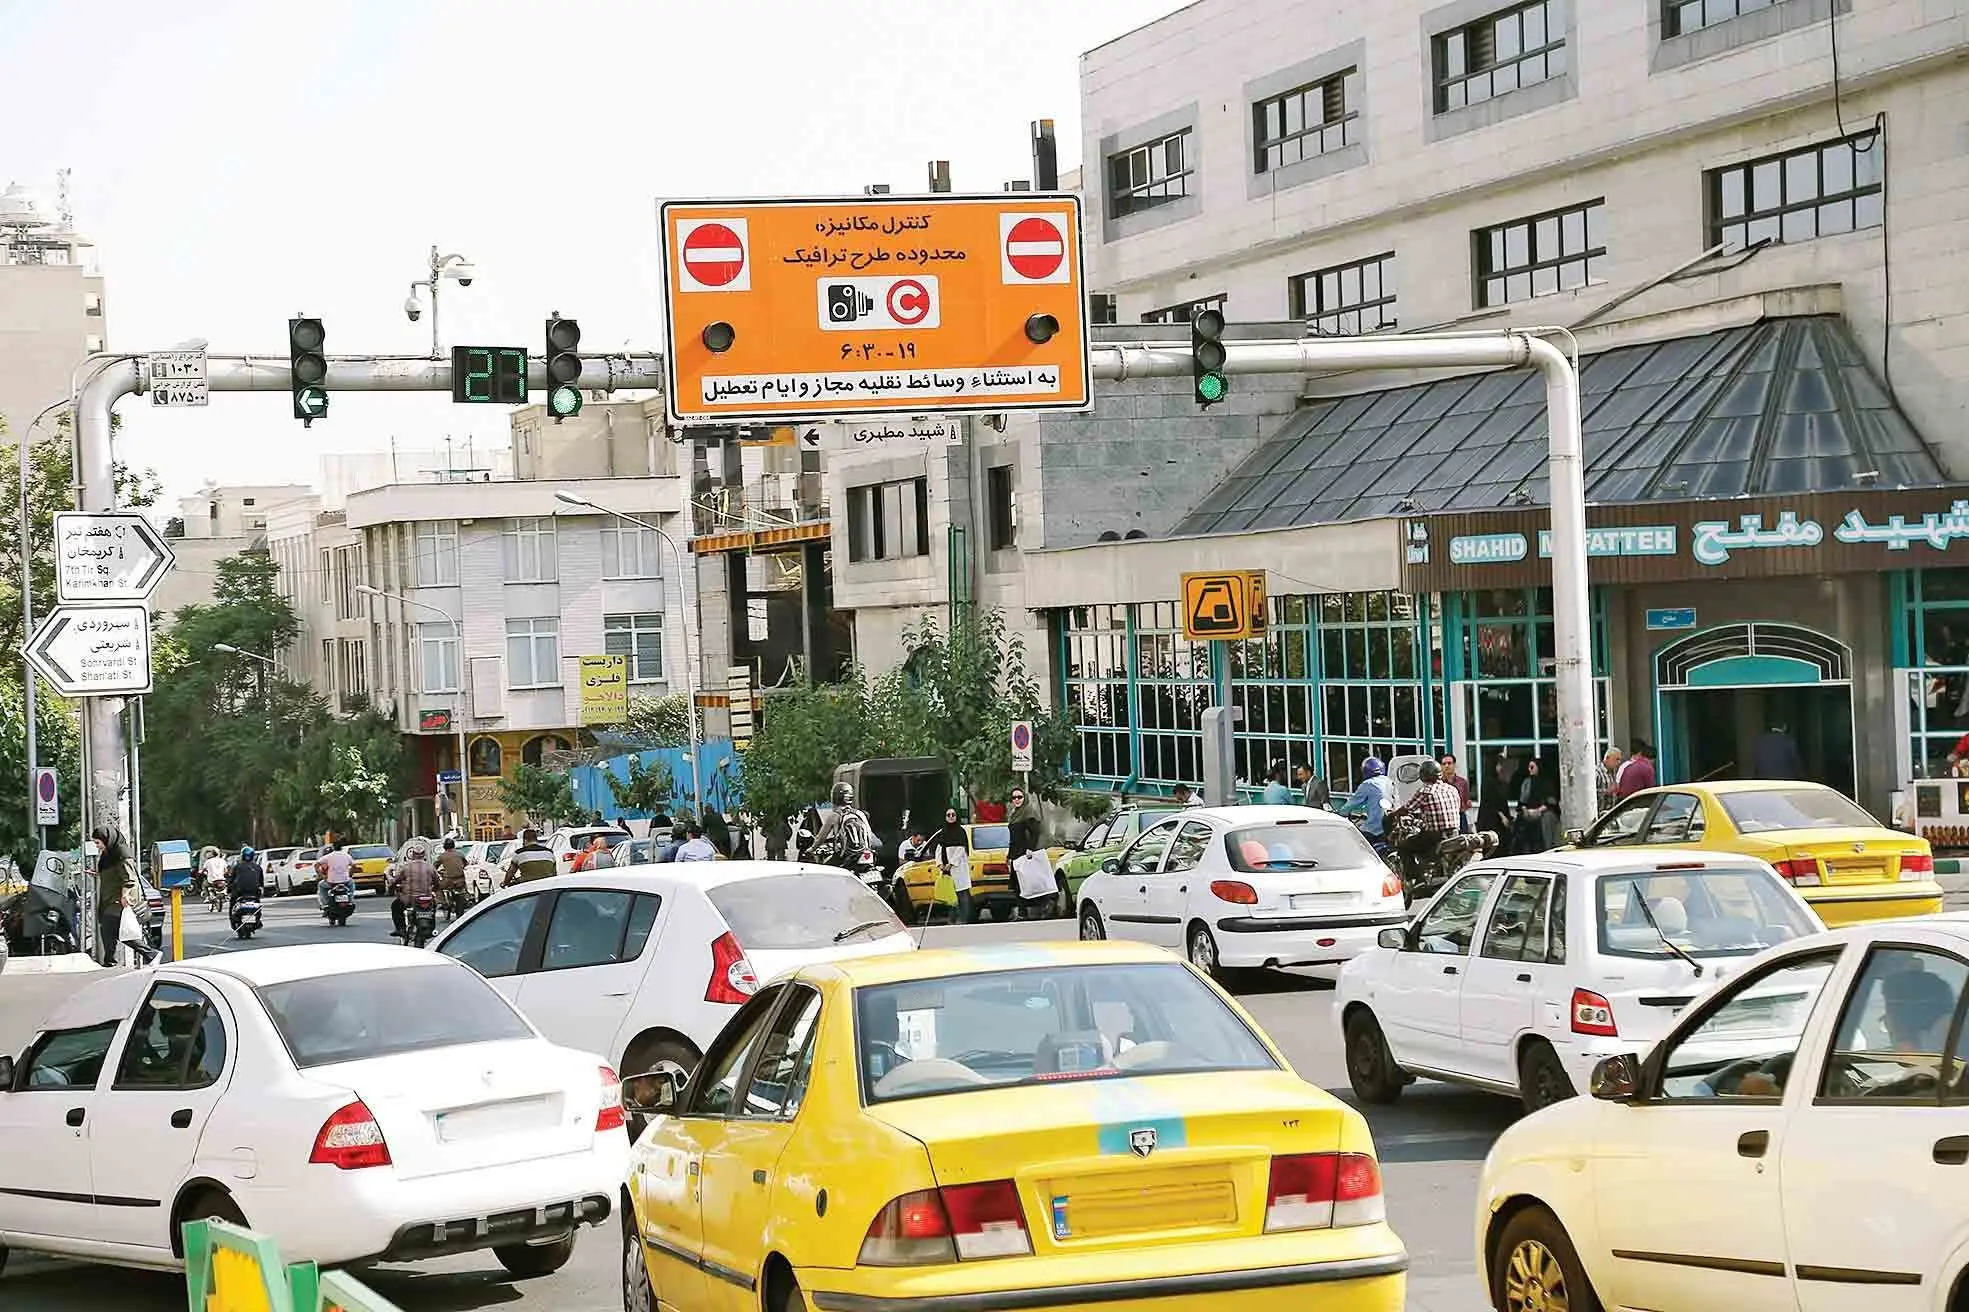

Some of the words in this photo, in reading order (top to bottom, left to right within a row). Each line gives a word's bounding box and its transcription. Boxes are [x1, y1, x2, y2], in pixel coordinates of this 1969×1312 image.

[815, 215, 880, 237] مکانیزه
[882, 214, 932, 235] کنترل
[783, 246, 848, 268] ترافیک
[849, 247, 890, 270] طرح
[896, 246, 967, 265] محدوده
[465, 348, 526, 401] 27
[858, 374, 902, 395] نقلیه
[906, 373, 965, 393] وسائط
[1037, 371, 1057, 388] به
[170, 392, 204, 402] ۸۷۵۰۰
[704, 379, 758, 402] تعطیل
[812, 376, 854, 398] مجاز
[853, 426, 905, 443] مطهری
[908, 423, 945, 440] شهید
[1452, 537, 1523, 559] SHAHID
[1694, 512, 1822, 564] مفتح
[586, 672, 620, 686] فلزی
